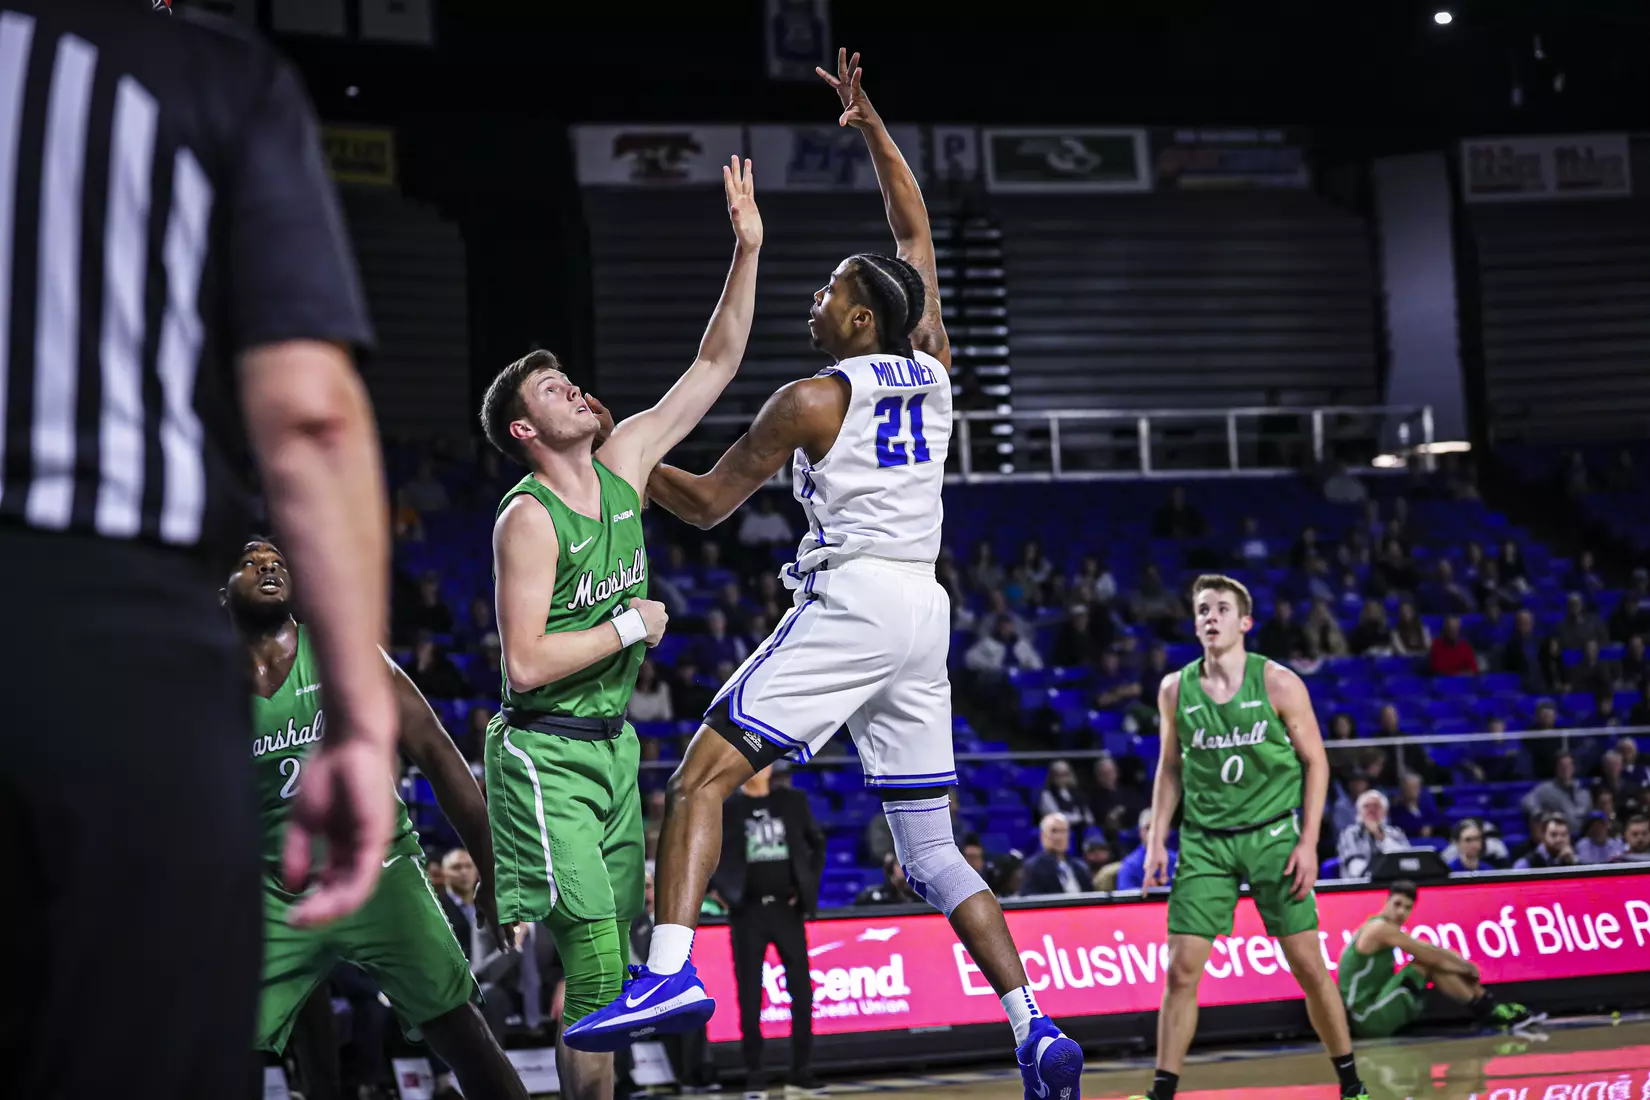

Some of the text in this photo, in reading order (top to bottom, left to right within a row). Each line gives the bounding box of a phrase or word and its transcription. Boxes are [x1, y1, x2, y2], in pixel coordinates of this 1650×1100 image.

[873, 392, 933, 470] 21
[566, 545, 646, 611] Marshall
[1190, 720, 1269, 750] Marshall
[1220, 754, 1245, 784] 0
[952, 929, 1168, 997] Eclusiv
[1475, 904, 1520, 959] of
[1525, 902, 1624, 955] Blue
